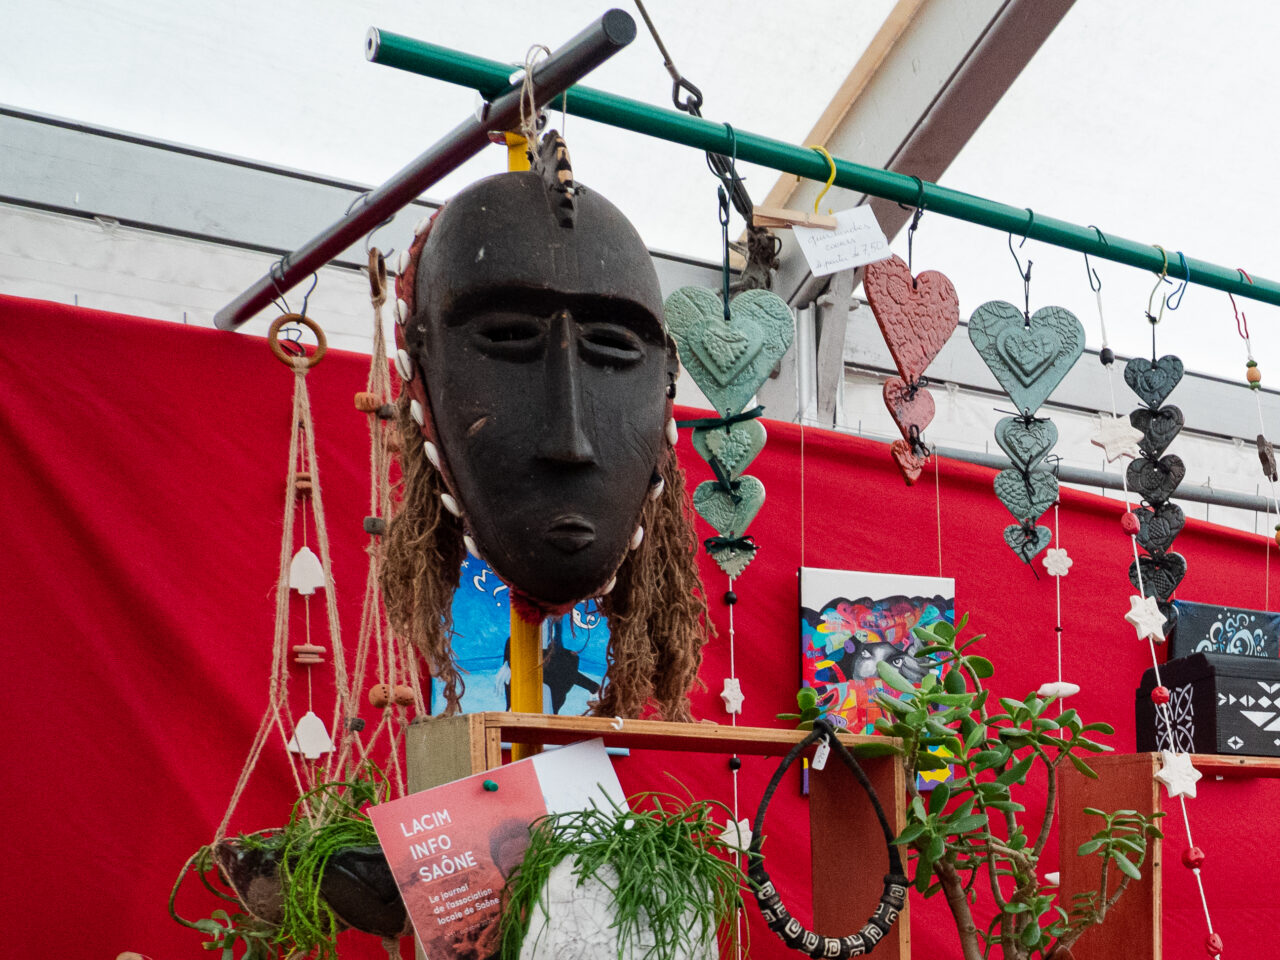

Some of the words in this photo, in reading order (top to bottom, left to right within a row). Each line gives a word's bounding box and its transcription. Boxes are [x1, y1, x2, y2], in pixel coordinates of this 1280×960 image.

[400, 808, 452, 838] LACIM
[409, 834, 452, 860] INFO
[419, 851, 478, 882] SAÔNE
[428, 894, 440, 904] Le
[441, 883, 469, 901] journal
[433, 905, 445, 915] de
[445, 887, 493, 910] l'association
[437, 911, 463, 925] locale
[464, 905, 475, 915] de
[475, 897, 500, 911] Saône
